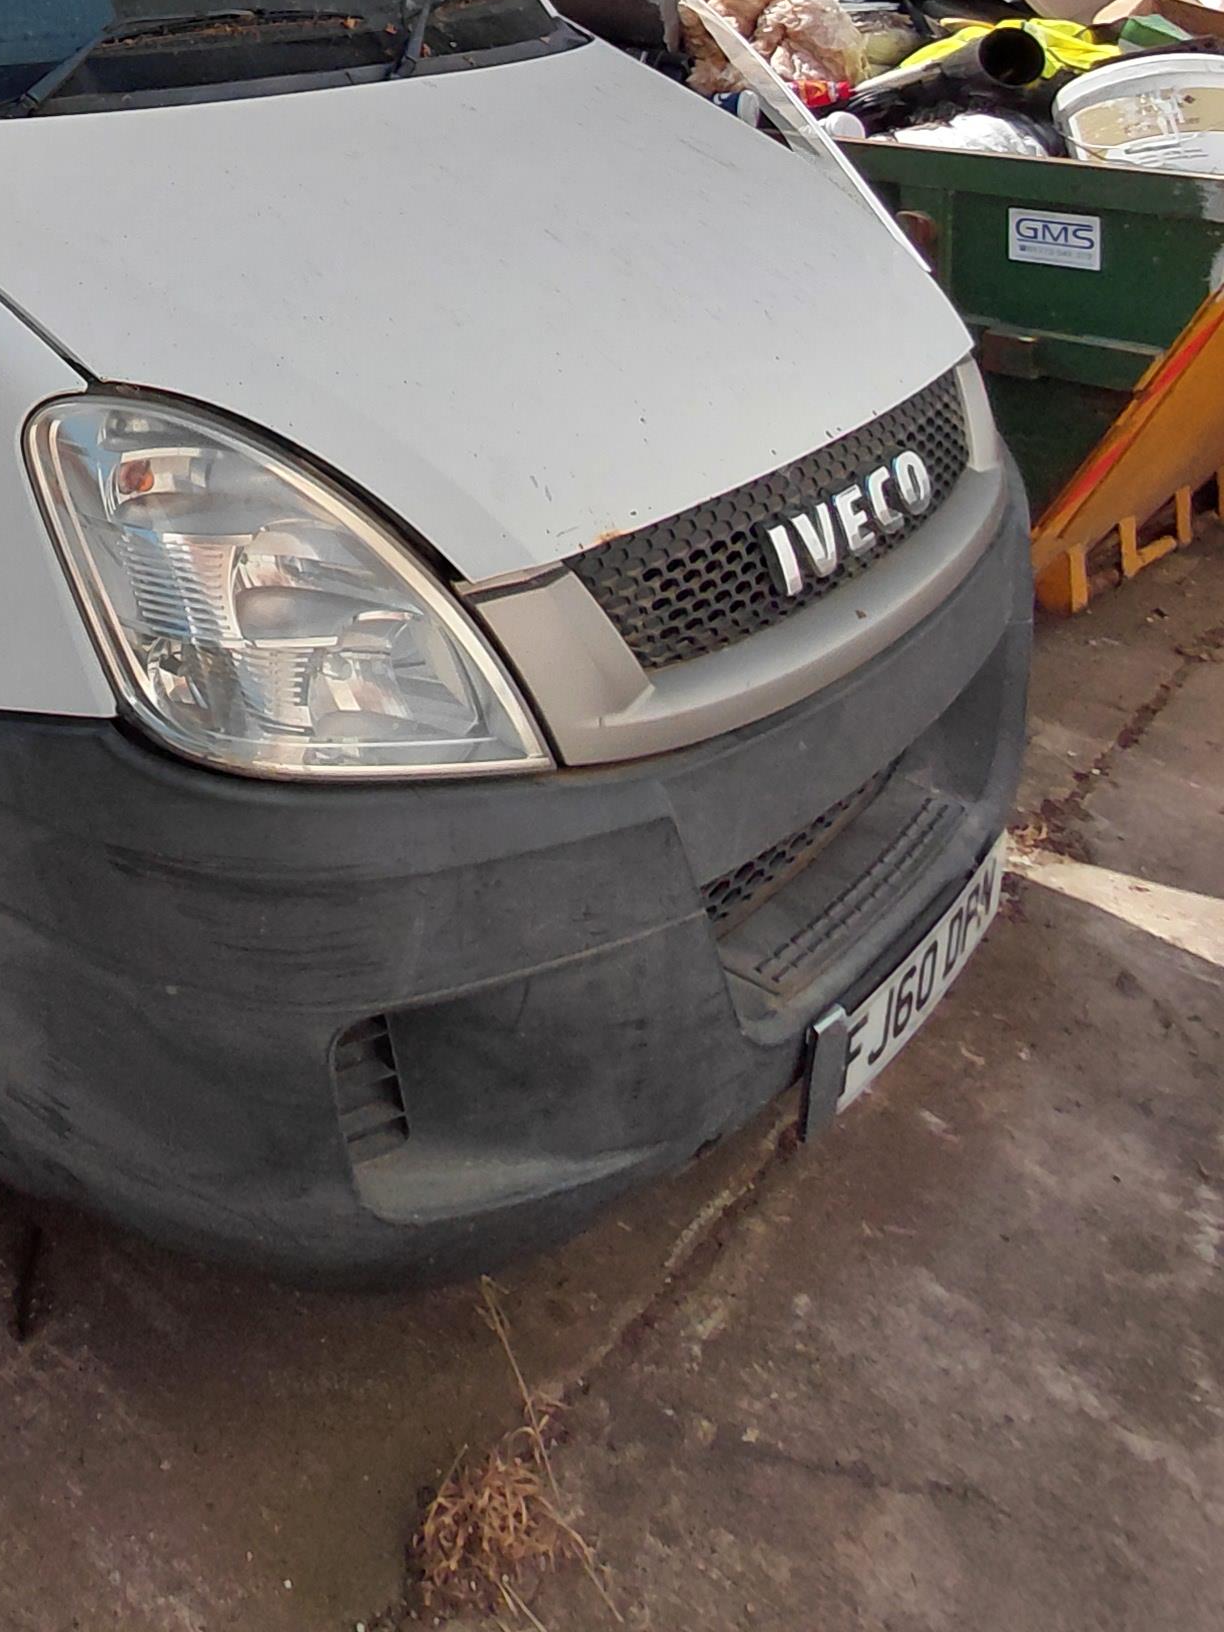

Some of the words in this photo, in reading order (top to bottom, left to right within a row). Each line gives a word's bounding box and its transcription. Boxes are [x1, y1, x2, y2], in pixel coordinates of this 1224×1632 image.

[1015, 217, 1095, 250] GMS
[767, 449, 931, 597] IVECO
[840, 938, 938, 1095] FJ60
